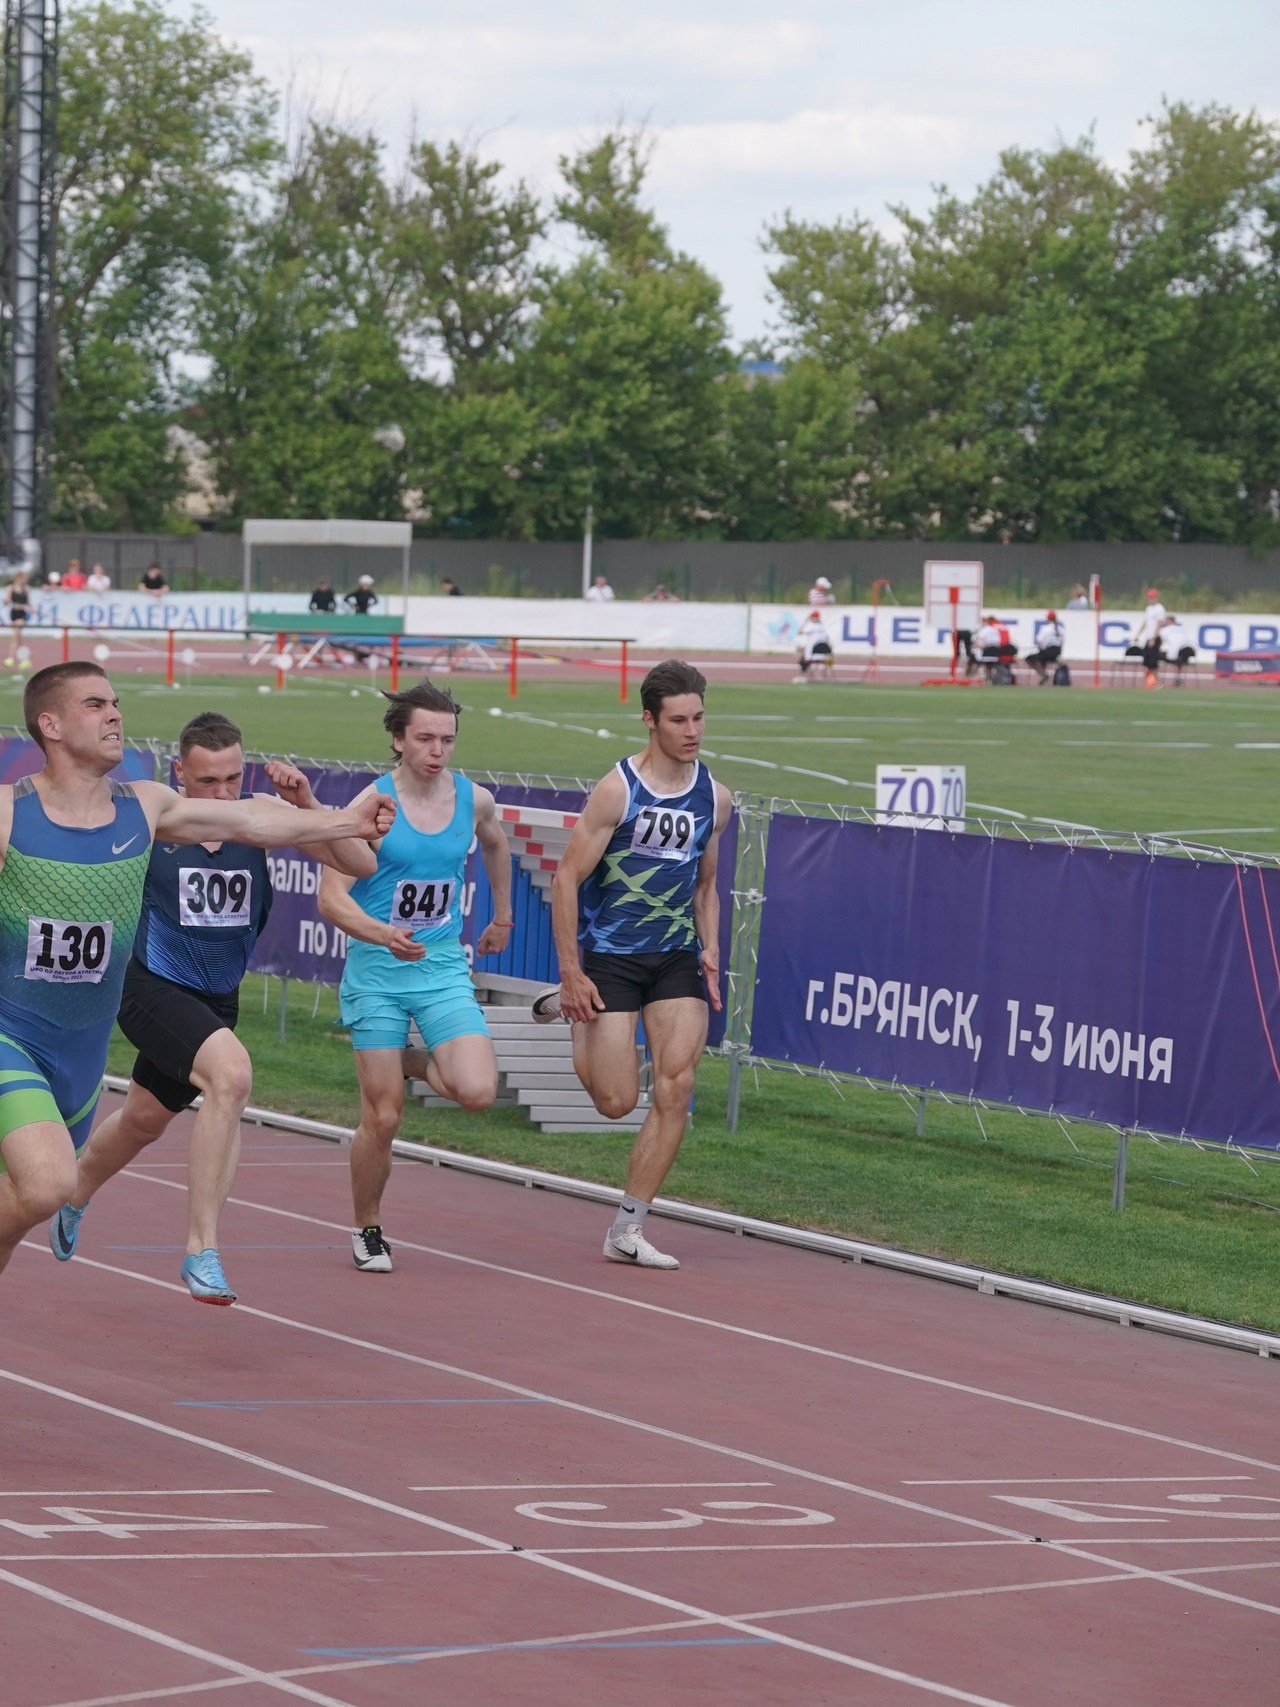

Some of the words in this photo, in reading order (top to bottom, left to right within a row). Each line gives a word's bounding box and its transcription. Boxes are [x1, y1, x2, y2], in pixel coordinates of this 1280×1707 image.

[78, 602, 278, 631] ФЕДЕРАЦИ
[881, 777, 935, 819] 70
[942, 777, 963, 818] 70
[640, 811, 690, 849] 799
[187, 871, 247, 914] 309
[399, 883, 450, 919] 841
[36, 922, 106, 971] 130
[806, 972, 982, 1062] г.БРЯНСК,
[1007, 1000, 1055, 1063] 1-3
